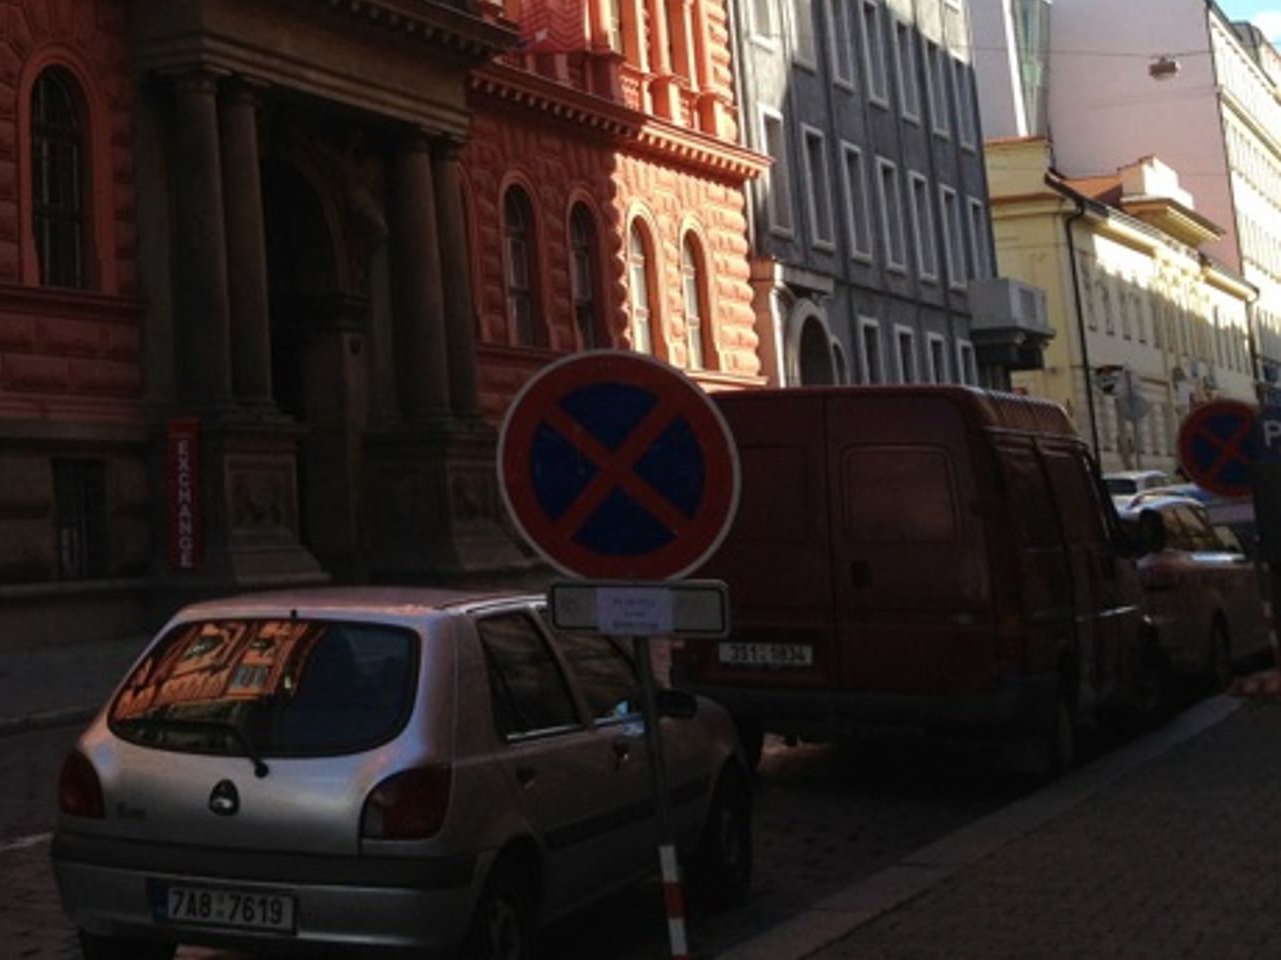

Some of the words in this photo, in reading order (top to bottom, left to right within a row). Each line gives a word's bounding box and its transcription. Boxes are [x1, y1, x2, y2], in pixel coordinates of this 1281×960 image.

[1263, 420, 1281, 448] P
[176, 439, 195, 570] EXCHANGE
[174, 891, 211, 918] 7A8
[229, 895, 283, 925] 7619
